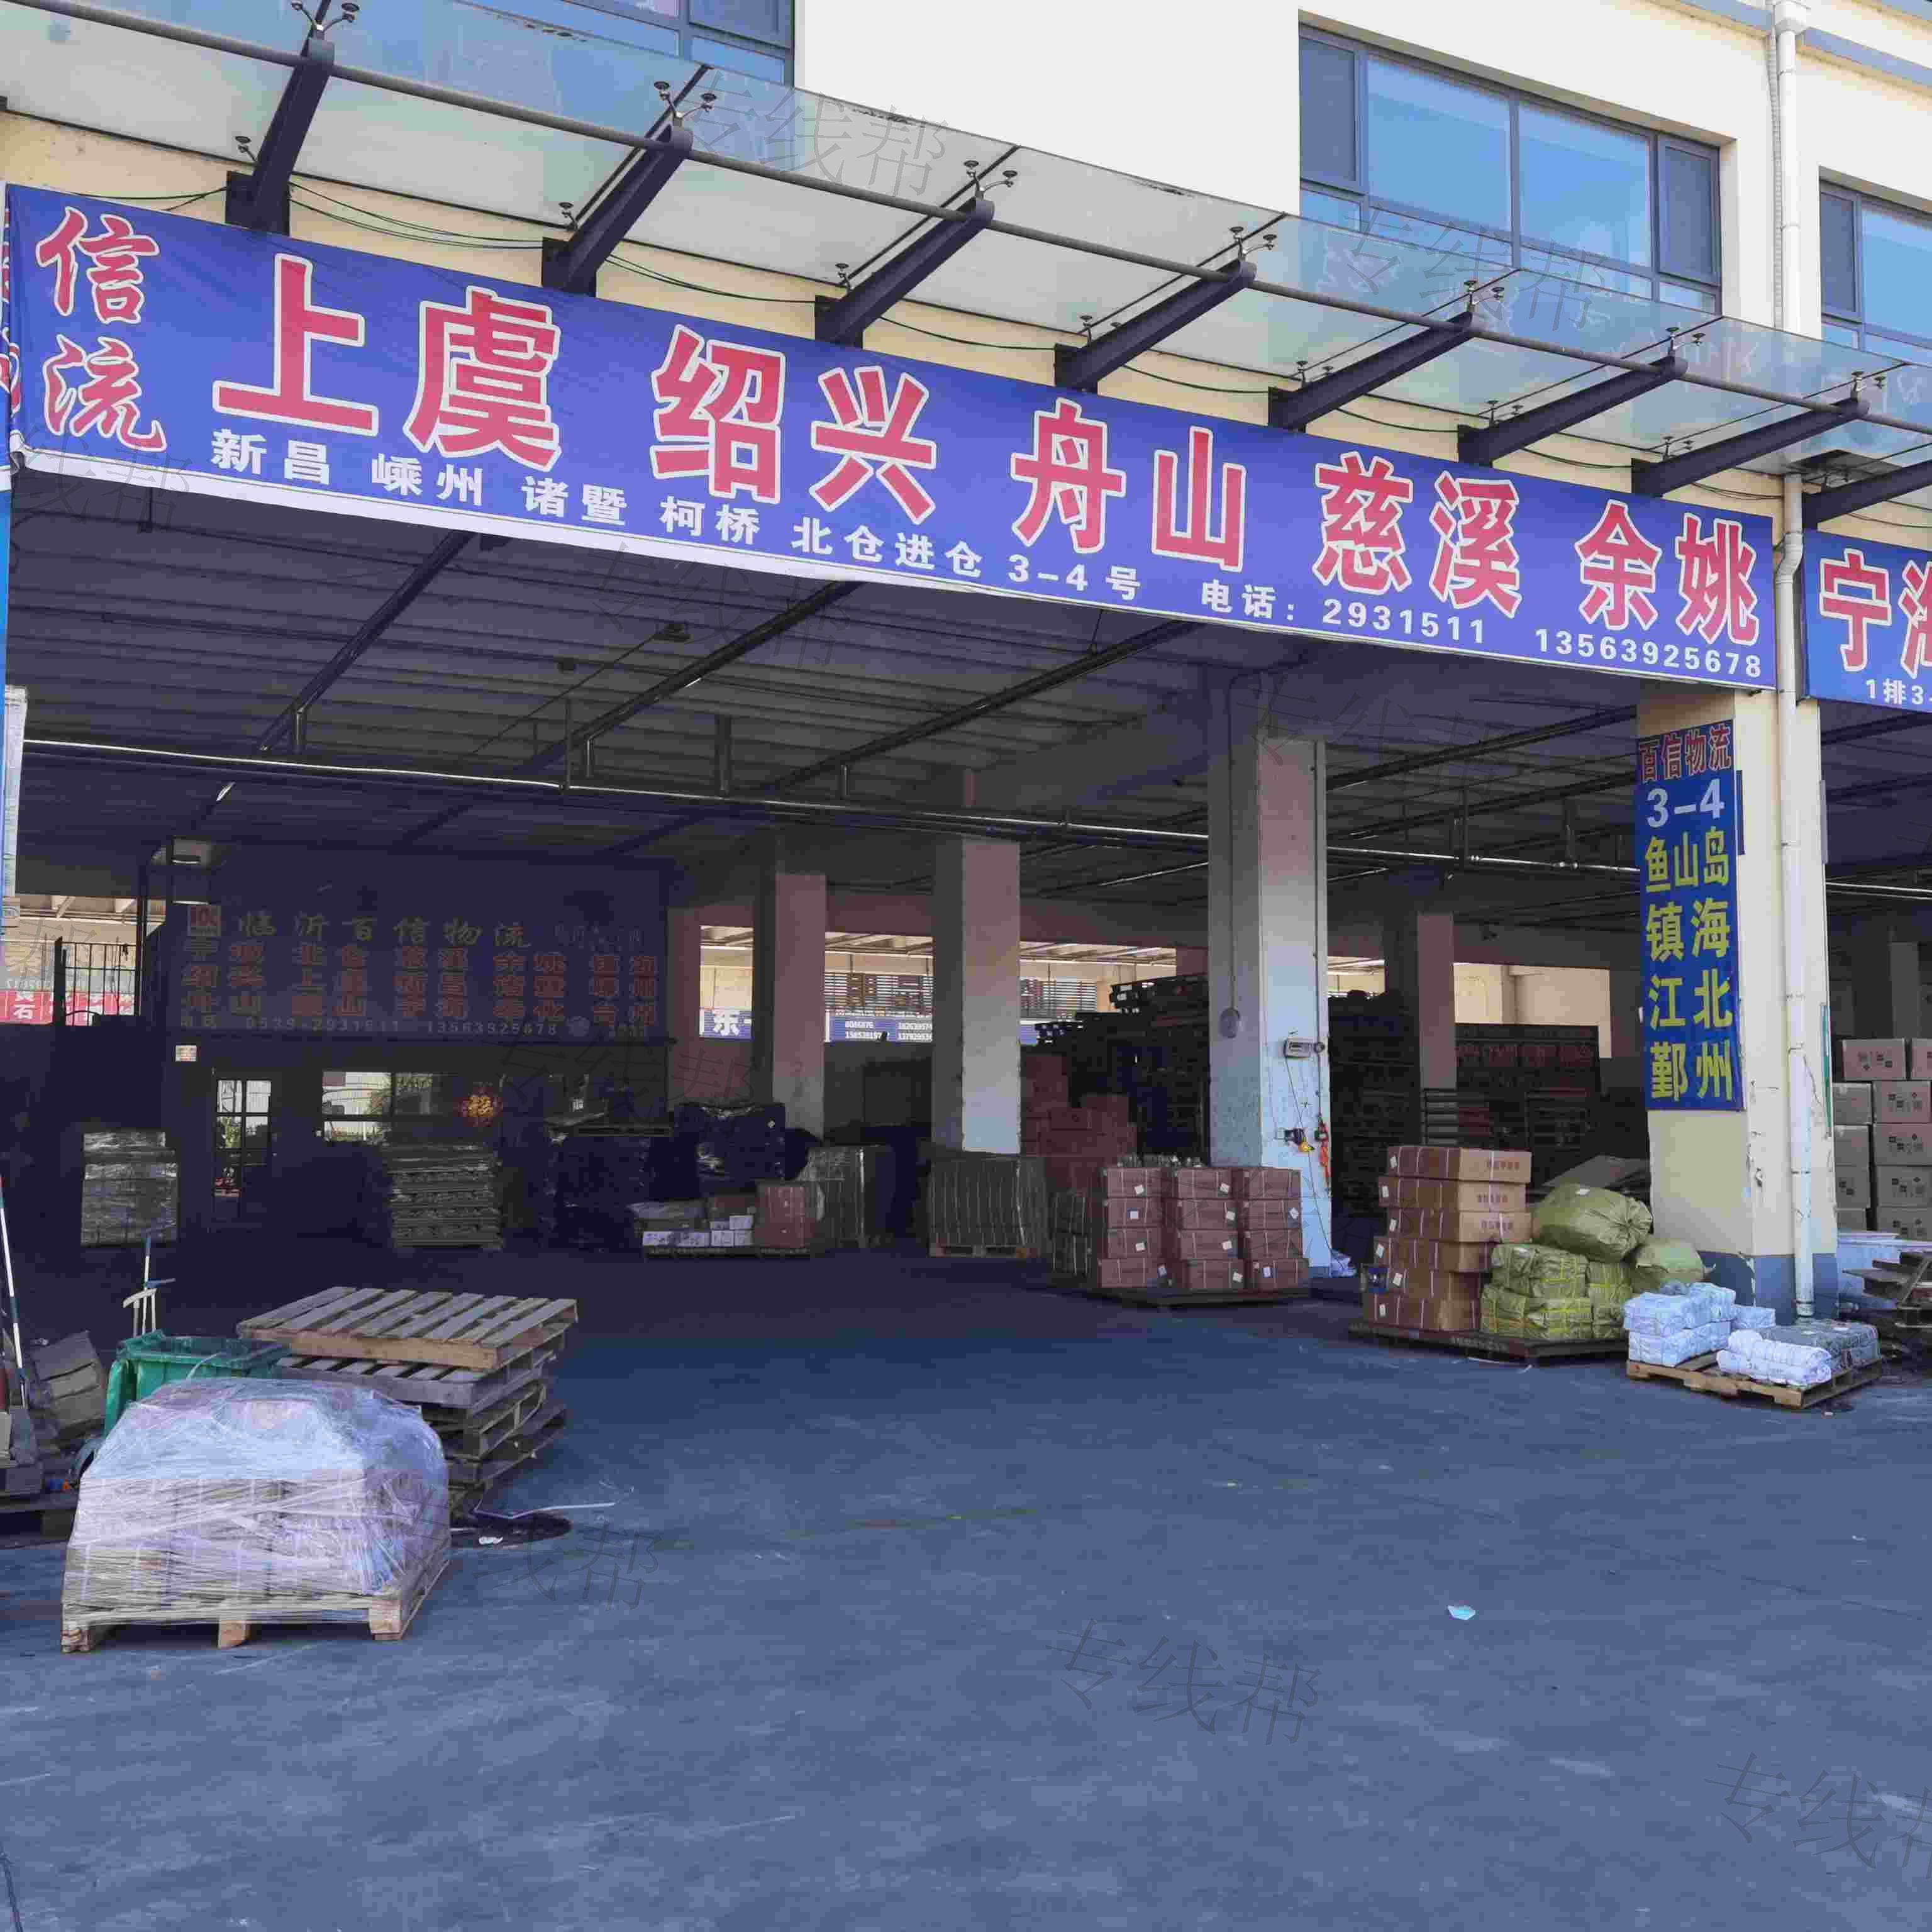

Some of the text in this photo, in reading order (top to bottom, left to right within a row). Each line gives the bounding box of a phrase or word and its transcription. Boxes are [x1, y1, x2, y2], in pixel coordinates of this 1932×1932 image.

[35, 207, 160, 325] 信
[43, 334, 167, 452] 流
[212, 253, 1760, 646] 上虞 绍兴 舟山 慈溪 余姚
[211, 428, 331, 484] 新昌
[372, 453, 482, 507] 嵊州
[521, 475, 626, 527] 诸暨
[660, 495, 760, 546] 柯桥
[1323, 598, 1484, 644] 2931511
[1536, 629, 1760, 678] 13563925678
[1638, 723, 1731, 782] 百信物流
[1647, 778, 1724, 828] 3-4
[1645, 826, 1729, 892] 鱼山岛
[1646, 897, 1730, 962] 镇海
[1648, 969, 1733, 1030] 江北
[1650, 1039, 1733, 1102] 鄞州
